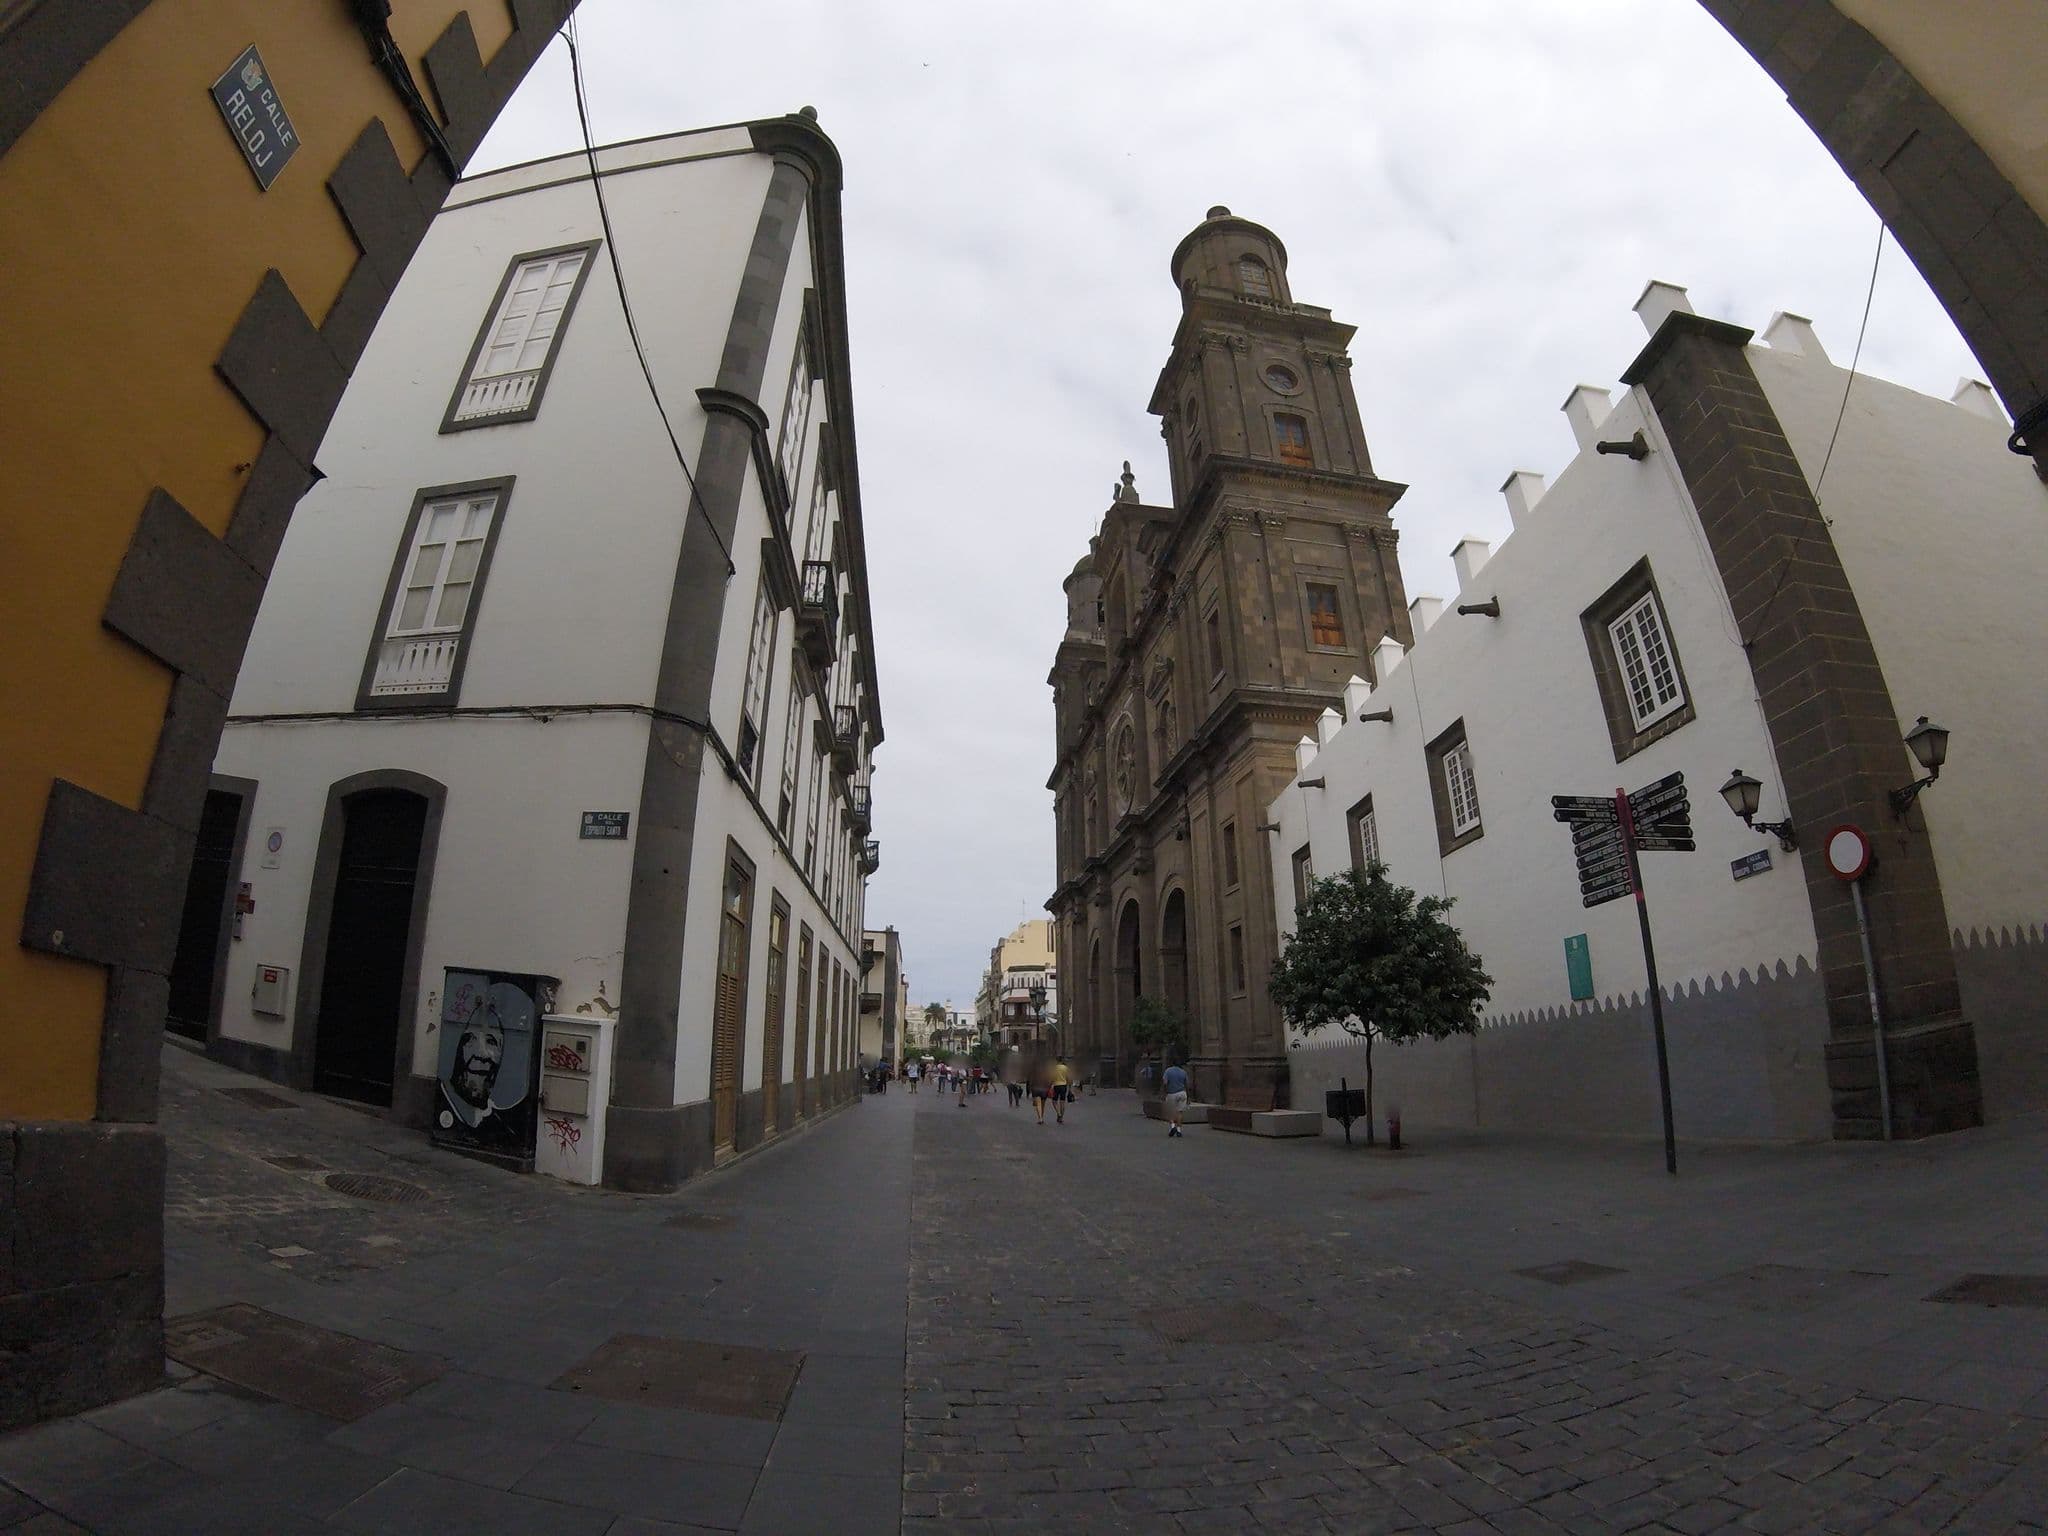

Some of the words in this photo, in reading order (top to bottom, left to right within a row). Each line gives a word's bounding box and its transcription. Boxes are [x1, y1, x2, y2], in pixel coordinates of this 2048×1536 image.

[225, 88, 273, 168] RELOJ
[260, 88, 293, 147] CALLE
[598, 813, 623, 821] CALLE
[1746, 853, 1761, 864] CALLE
